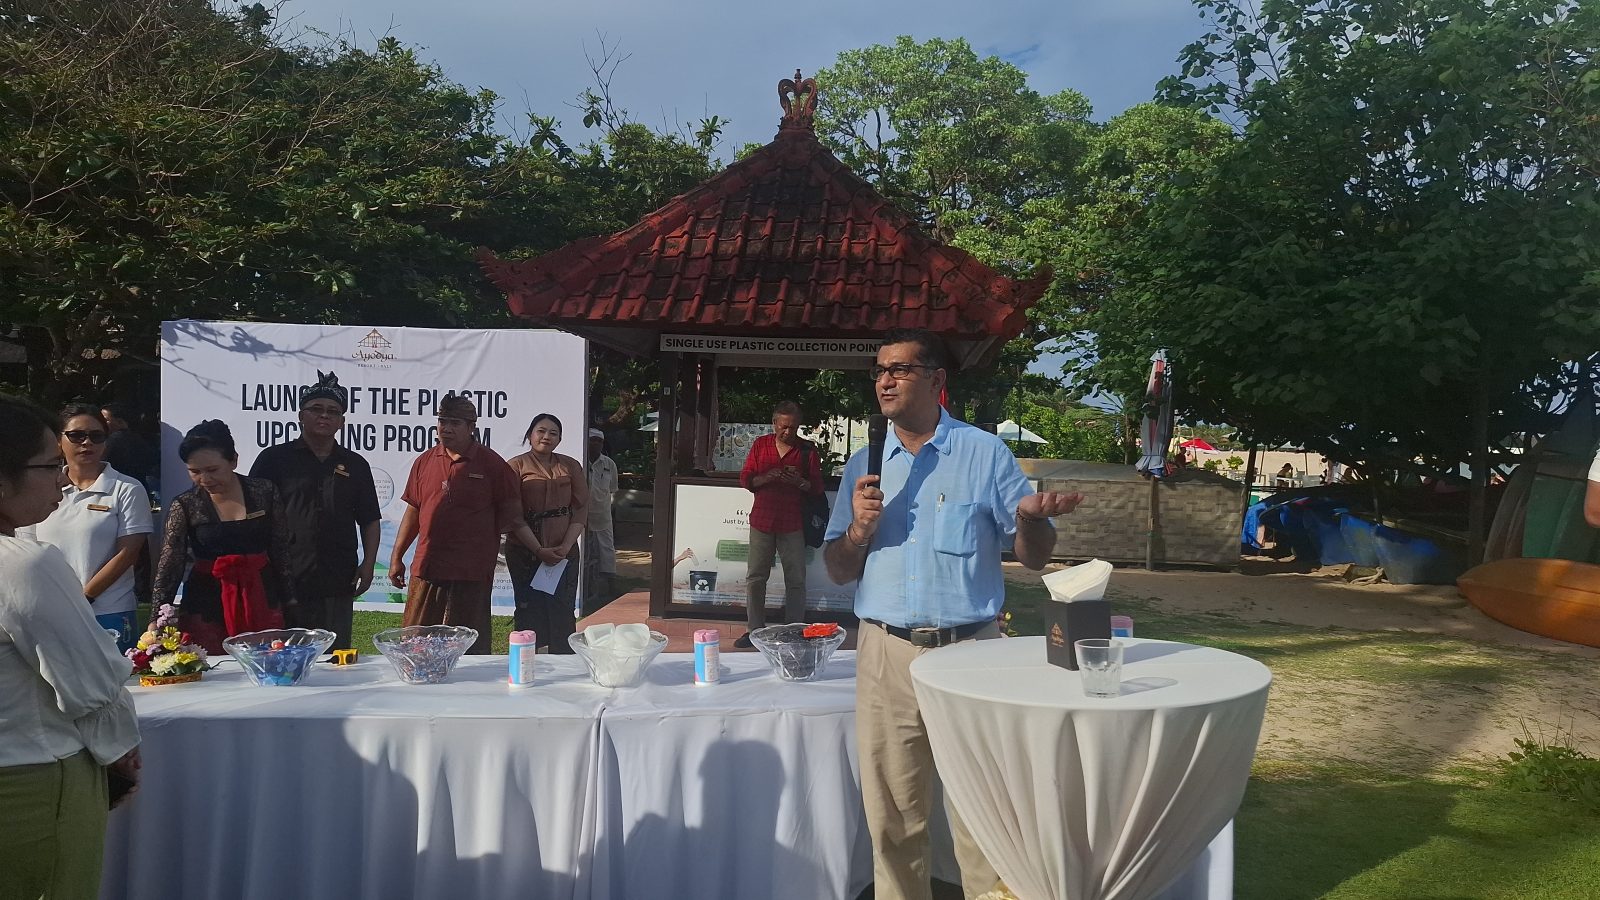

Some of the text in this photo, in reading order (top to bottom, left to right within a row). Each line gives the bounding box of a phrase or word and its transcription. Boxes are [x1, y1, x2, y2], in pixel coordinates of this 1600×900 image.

[665, 338, 704, 348] SINGLE
[706, 340, 727, 349] USE
[729, 341, 775, 350] PLASTIC
[777, 342, 847, 352] COLLECTION
[351, 349, 394, 363] Ayodya
[368, 387, 411, 415] THE
[384, 424, 491, 452] PROGM
